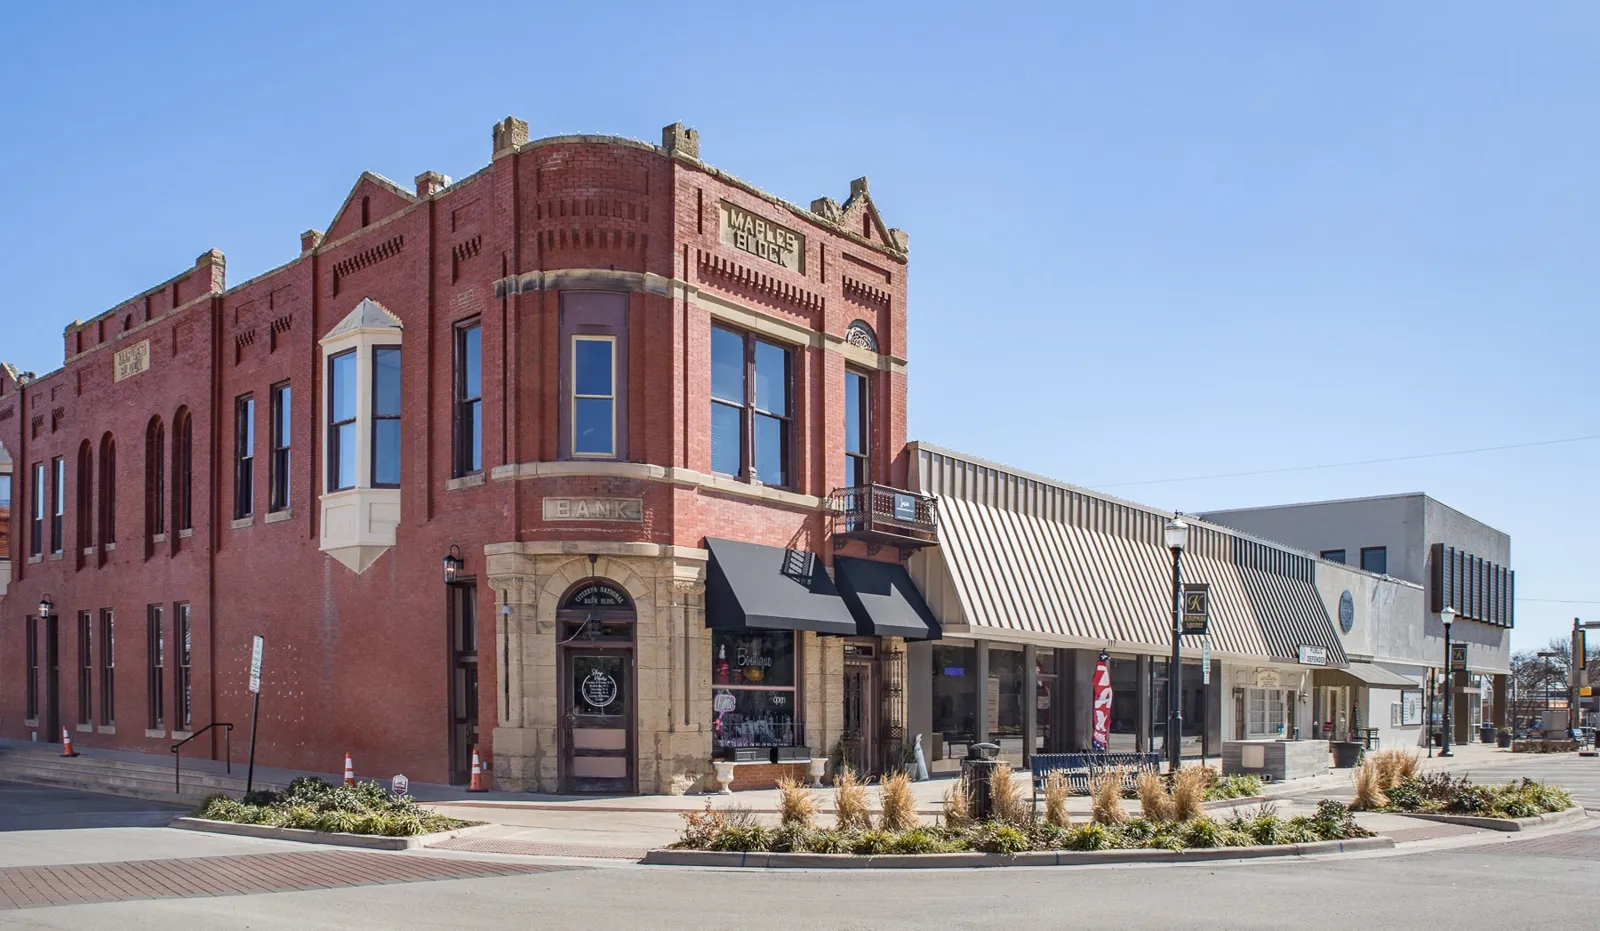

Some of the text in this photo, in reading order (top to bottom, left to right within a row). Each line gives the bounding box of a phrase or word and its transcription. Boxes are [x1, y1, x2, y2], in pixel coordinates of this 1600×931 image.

[737, 230, 788, 266] BLOCK
[555, 499, 628, 518] BANK
[600, 587, 624, 604] NATIONAL
[1188, 595, 1204, 611] K
[773, 696, 786, 705] open
[1056, 766, 1090, 774] WELCOME
[1094, 765, 1103, 774] TO
